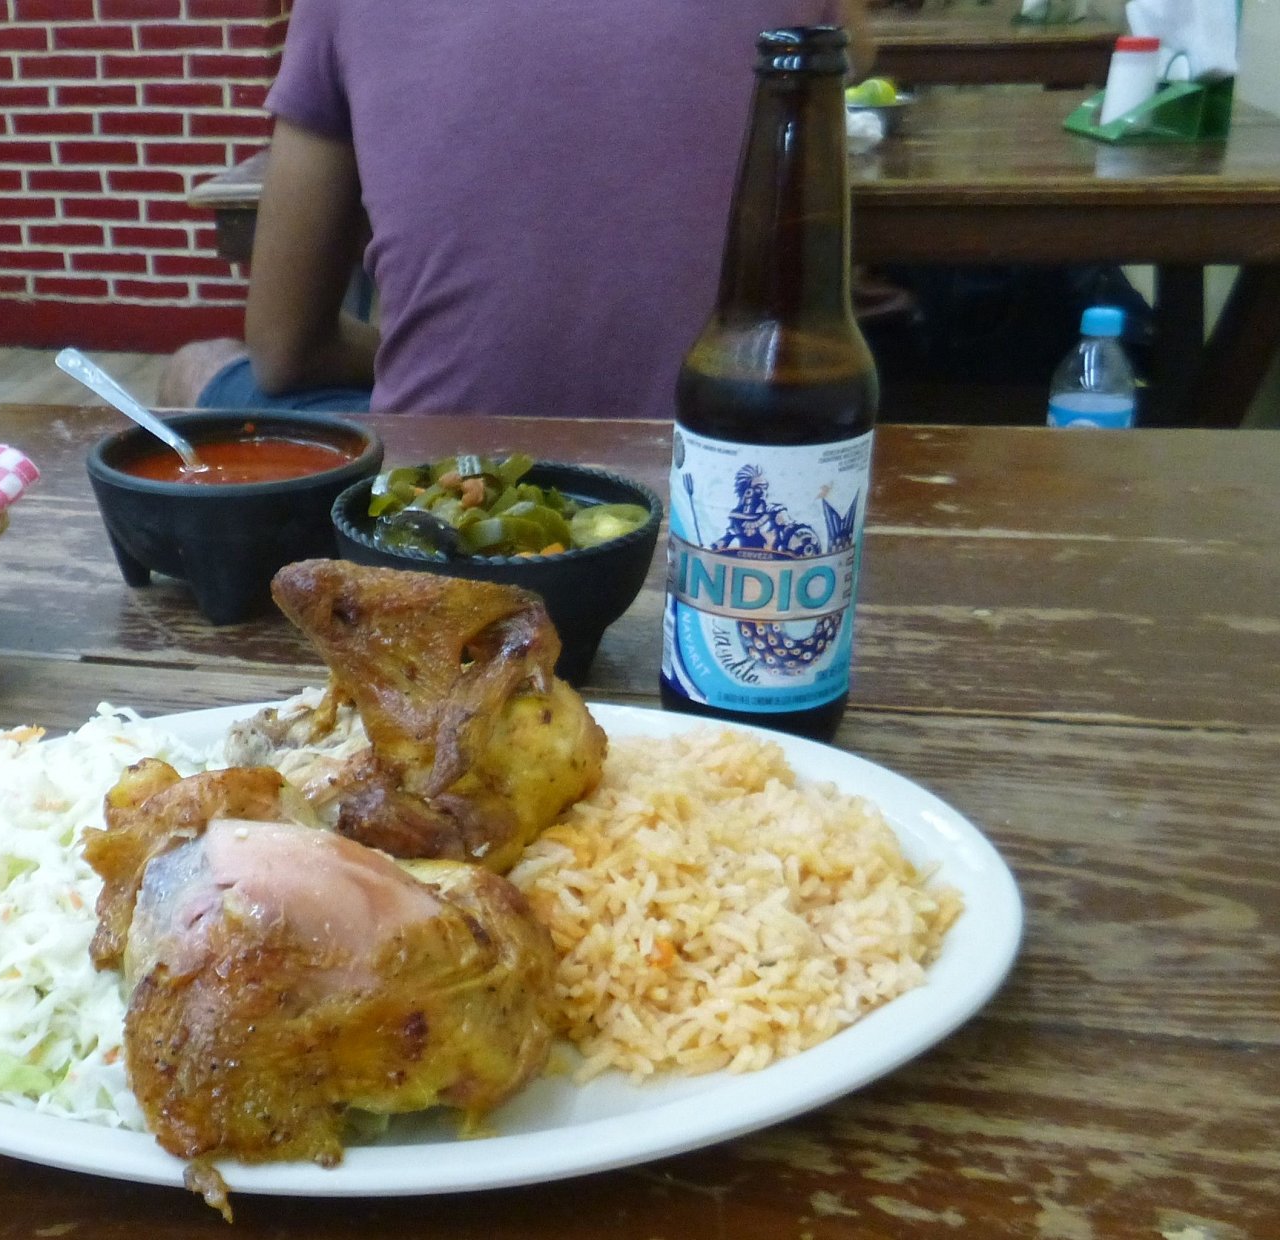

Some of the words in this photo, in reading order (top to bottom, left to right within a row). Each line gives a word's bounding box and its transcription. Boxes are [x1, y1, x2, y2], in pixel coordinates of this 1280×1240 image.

[678, 552, 837, 612] INDIO
[736, 550, 774, 560] CERVEZA
[681, 611, 711, 677] NAYARIT
